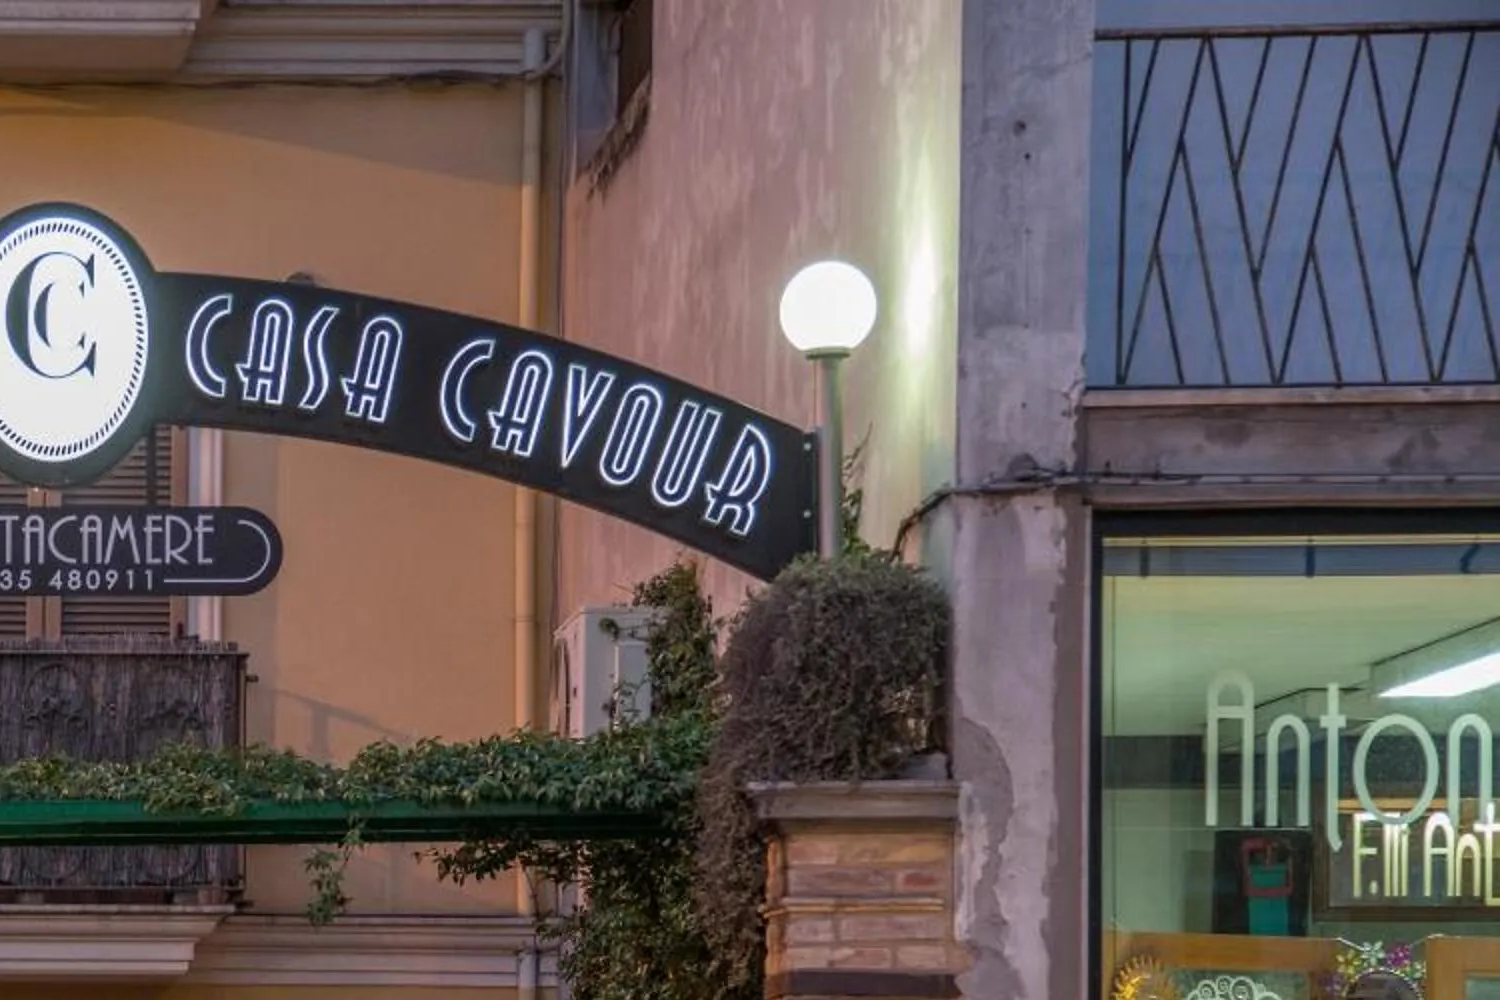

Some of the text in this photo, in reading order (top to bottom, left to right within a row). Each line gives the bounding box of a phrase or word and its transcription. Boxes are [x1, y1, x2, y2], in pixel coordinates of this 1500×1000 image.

[185, 293, 773, 537] CASA CAVOUR
[48, 568, 155, 591] 480911
